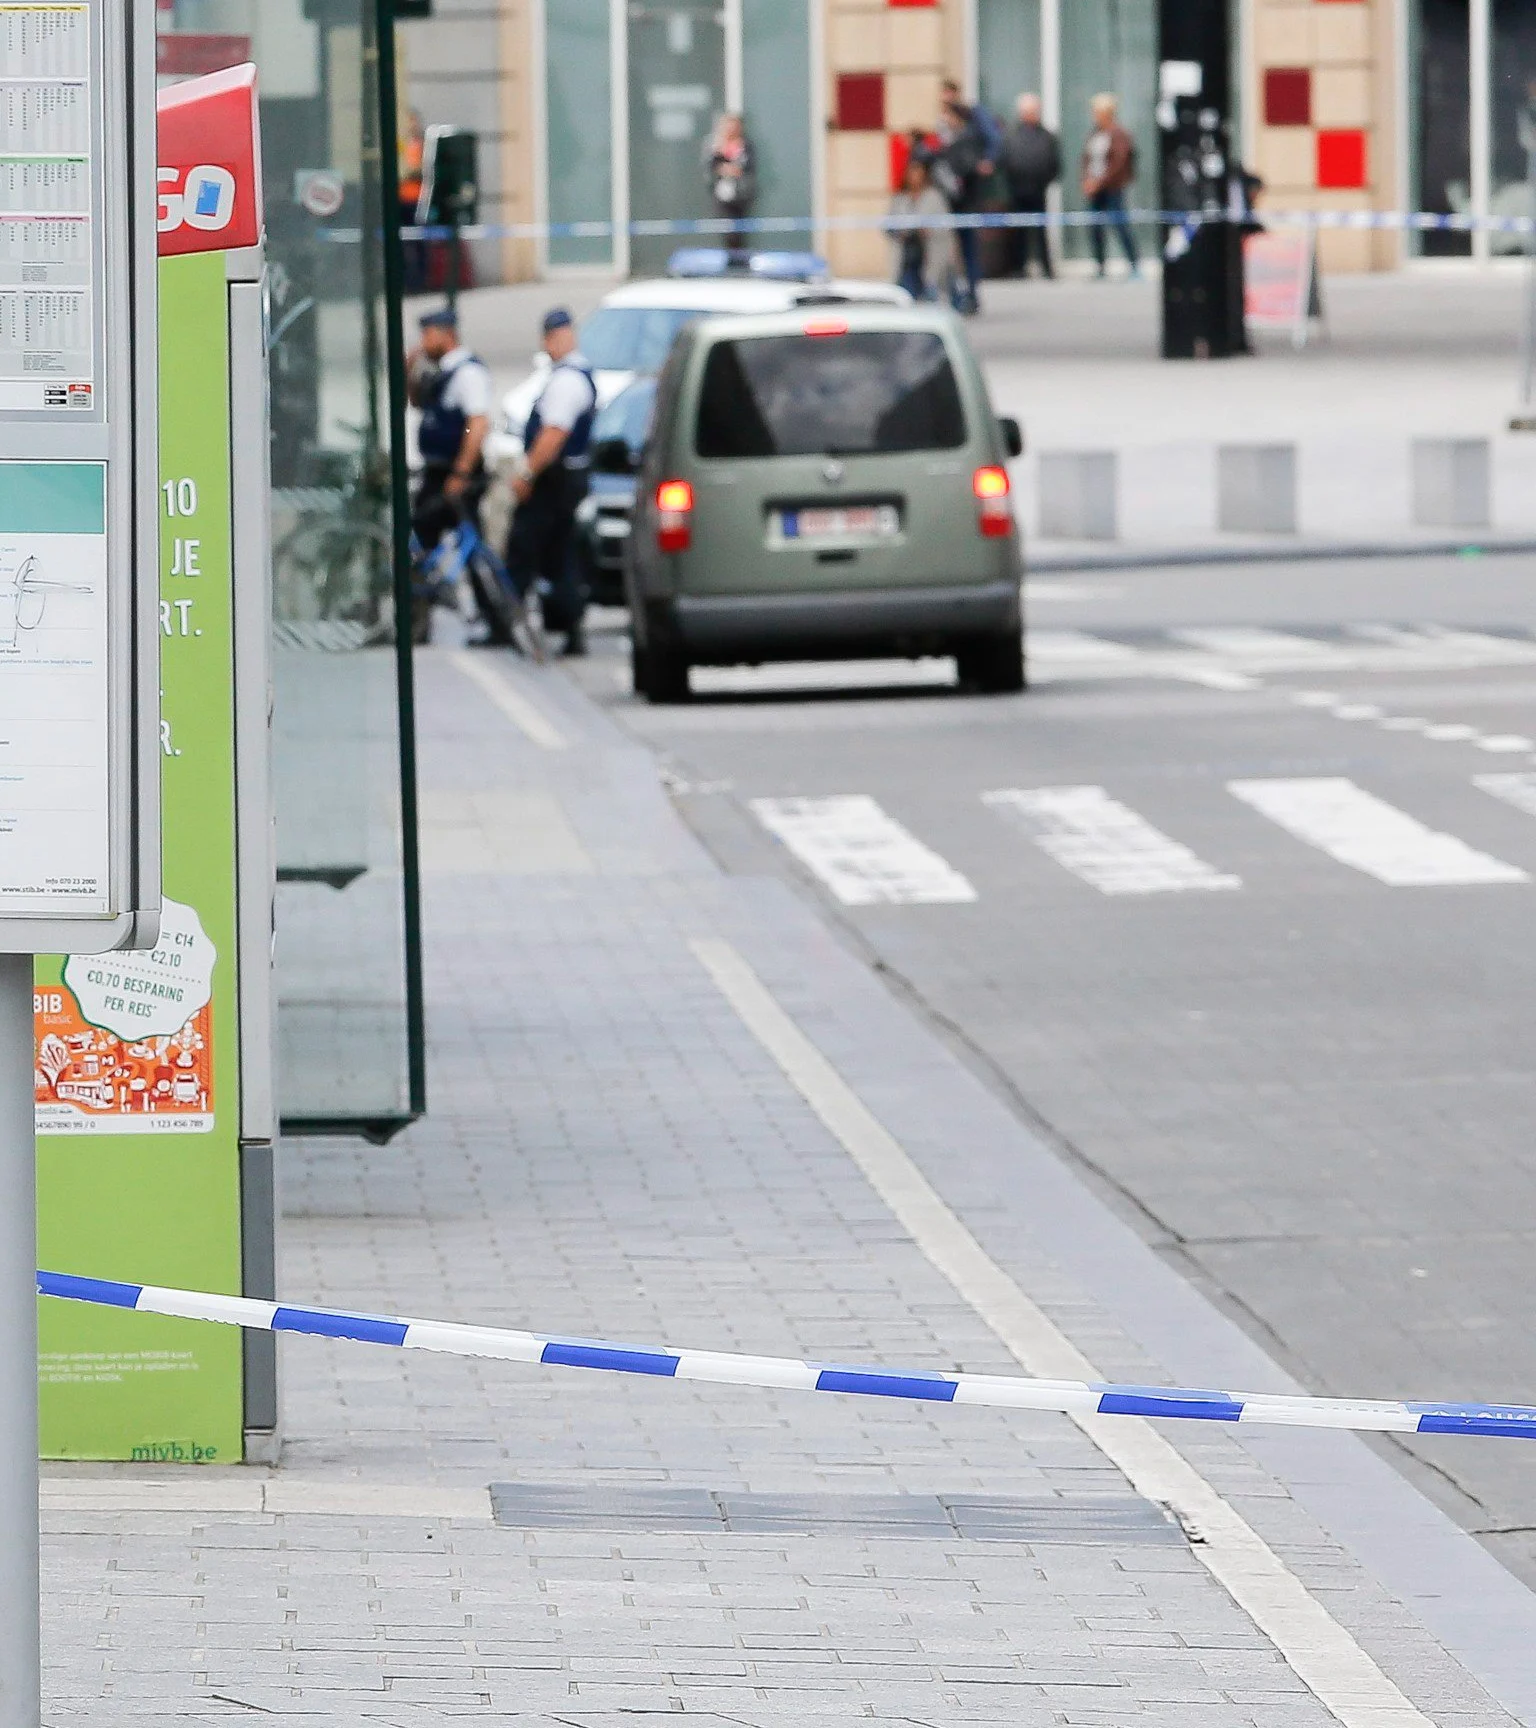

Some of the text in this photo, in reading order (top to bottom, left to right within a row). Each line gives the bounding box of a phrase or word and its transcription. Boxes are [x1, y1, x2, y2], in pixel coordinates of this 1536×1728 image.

[162, 477, 197, 517] 10
[170, 538, 201, 577] JE
[45, 877, 58, 885] Info
[175, 932, 194, 948] €14
[151, 950, 182, 968] €2.10
[87, 970, 184, 1002] €0.70 BESPARING
[104, 995, 125, 1012] PER
